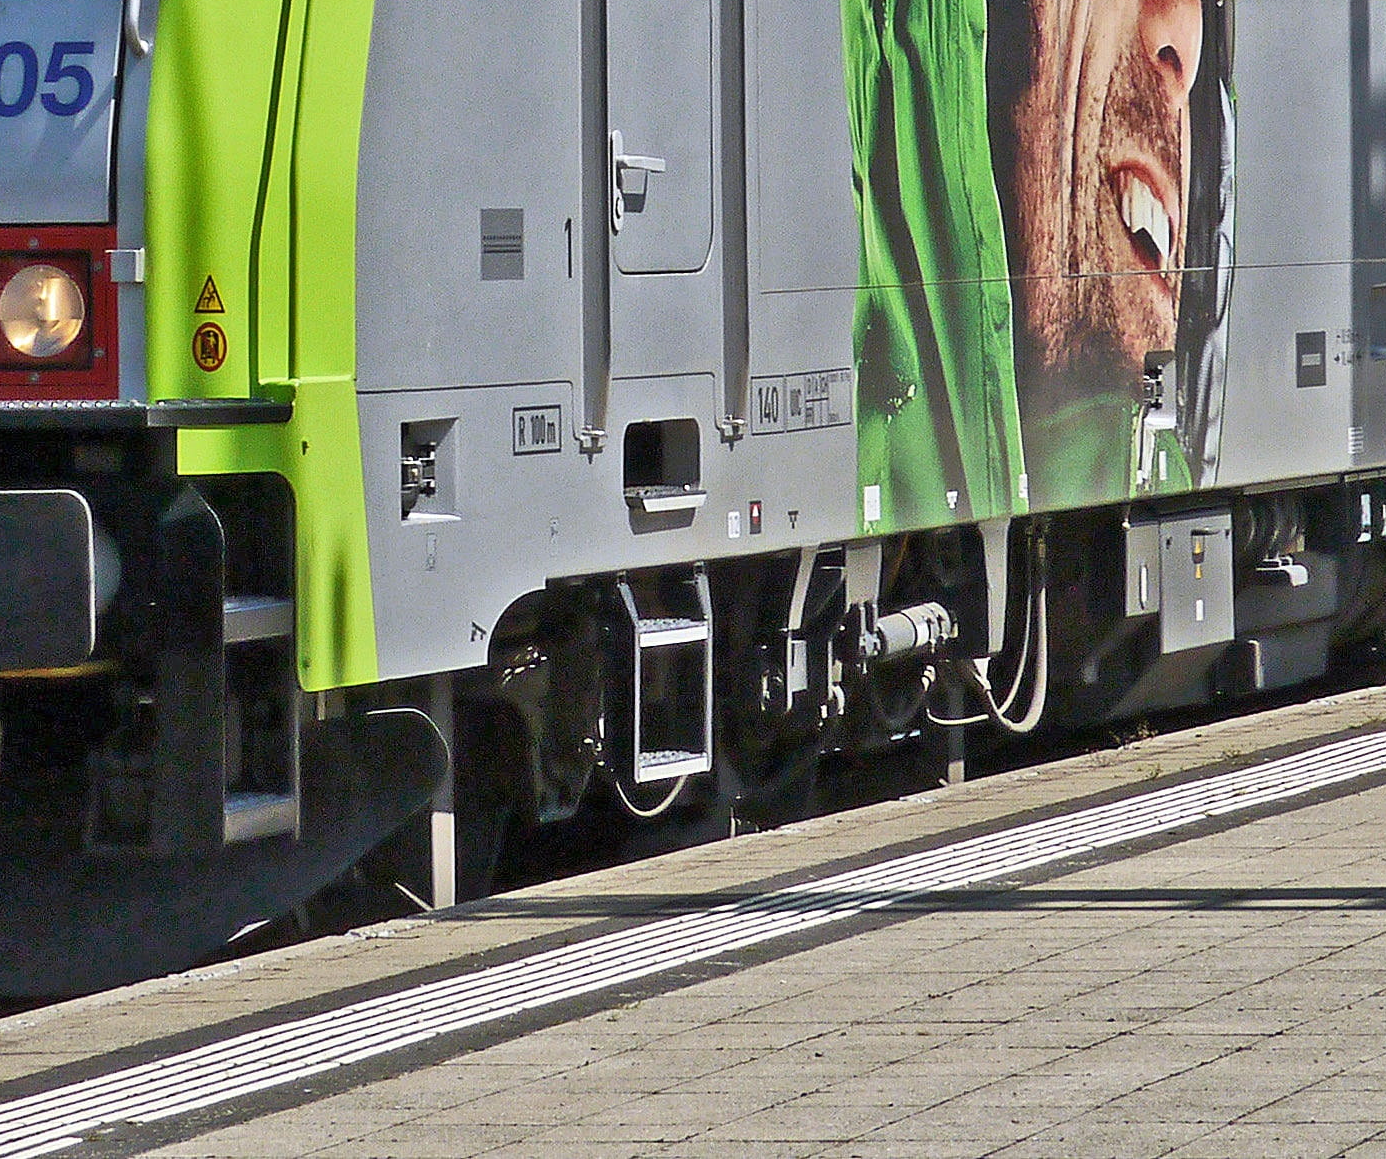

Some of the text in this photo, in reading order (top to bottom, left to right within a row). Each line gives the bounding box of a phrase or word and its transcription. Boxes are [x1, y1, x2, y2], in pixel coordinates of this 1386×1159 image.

[564, 217, 573, 279] 1
[757, 386, 779, 424] 140
[518, 416, 526, 447] R
